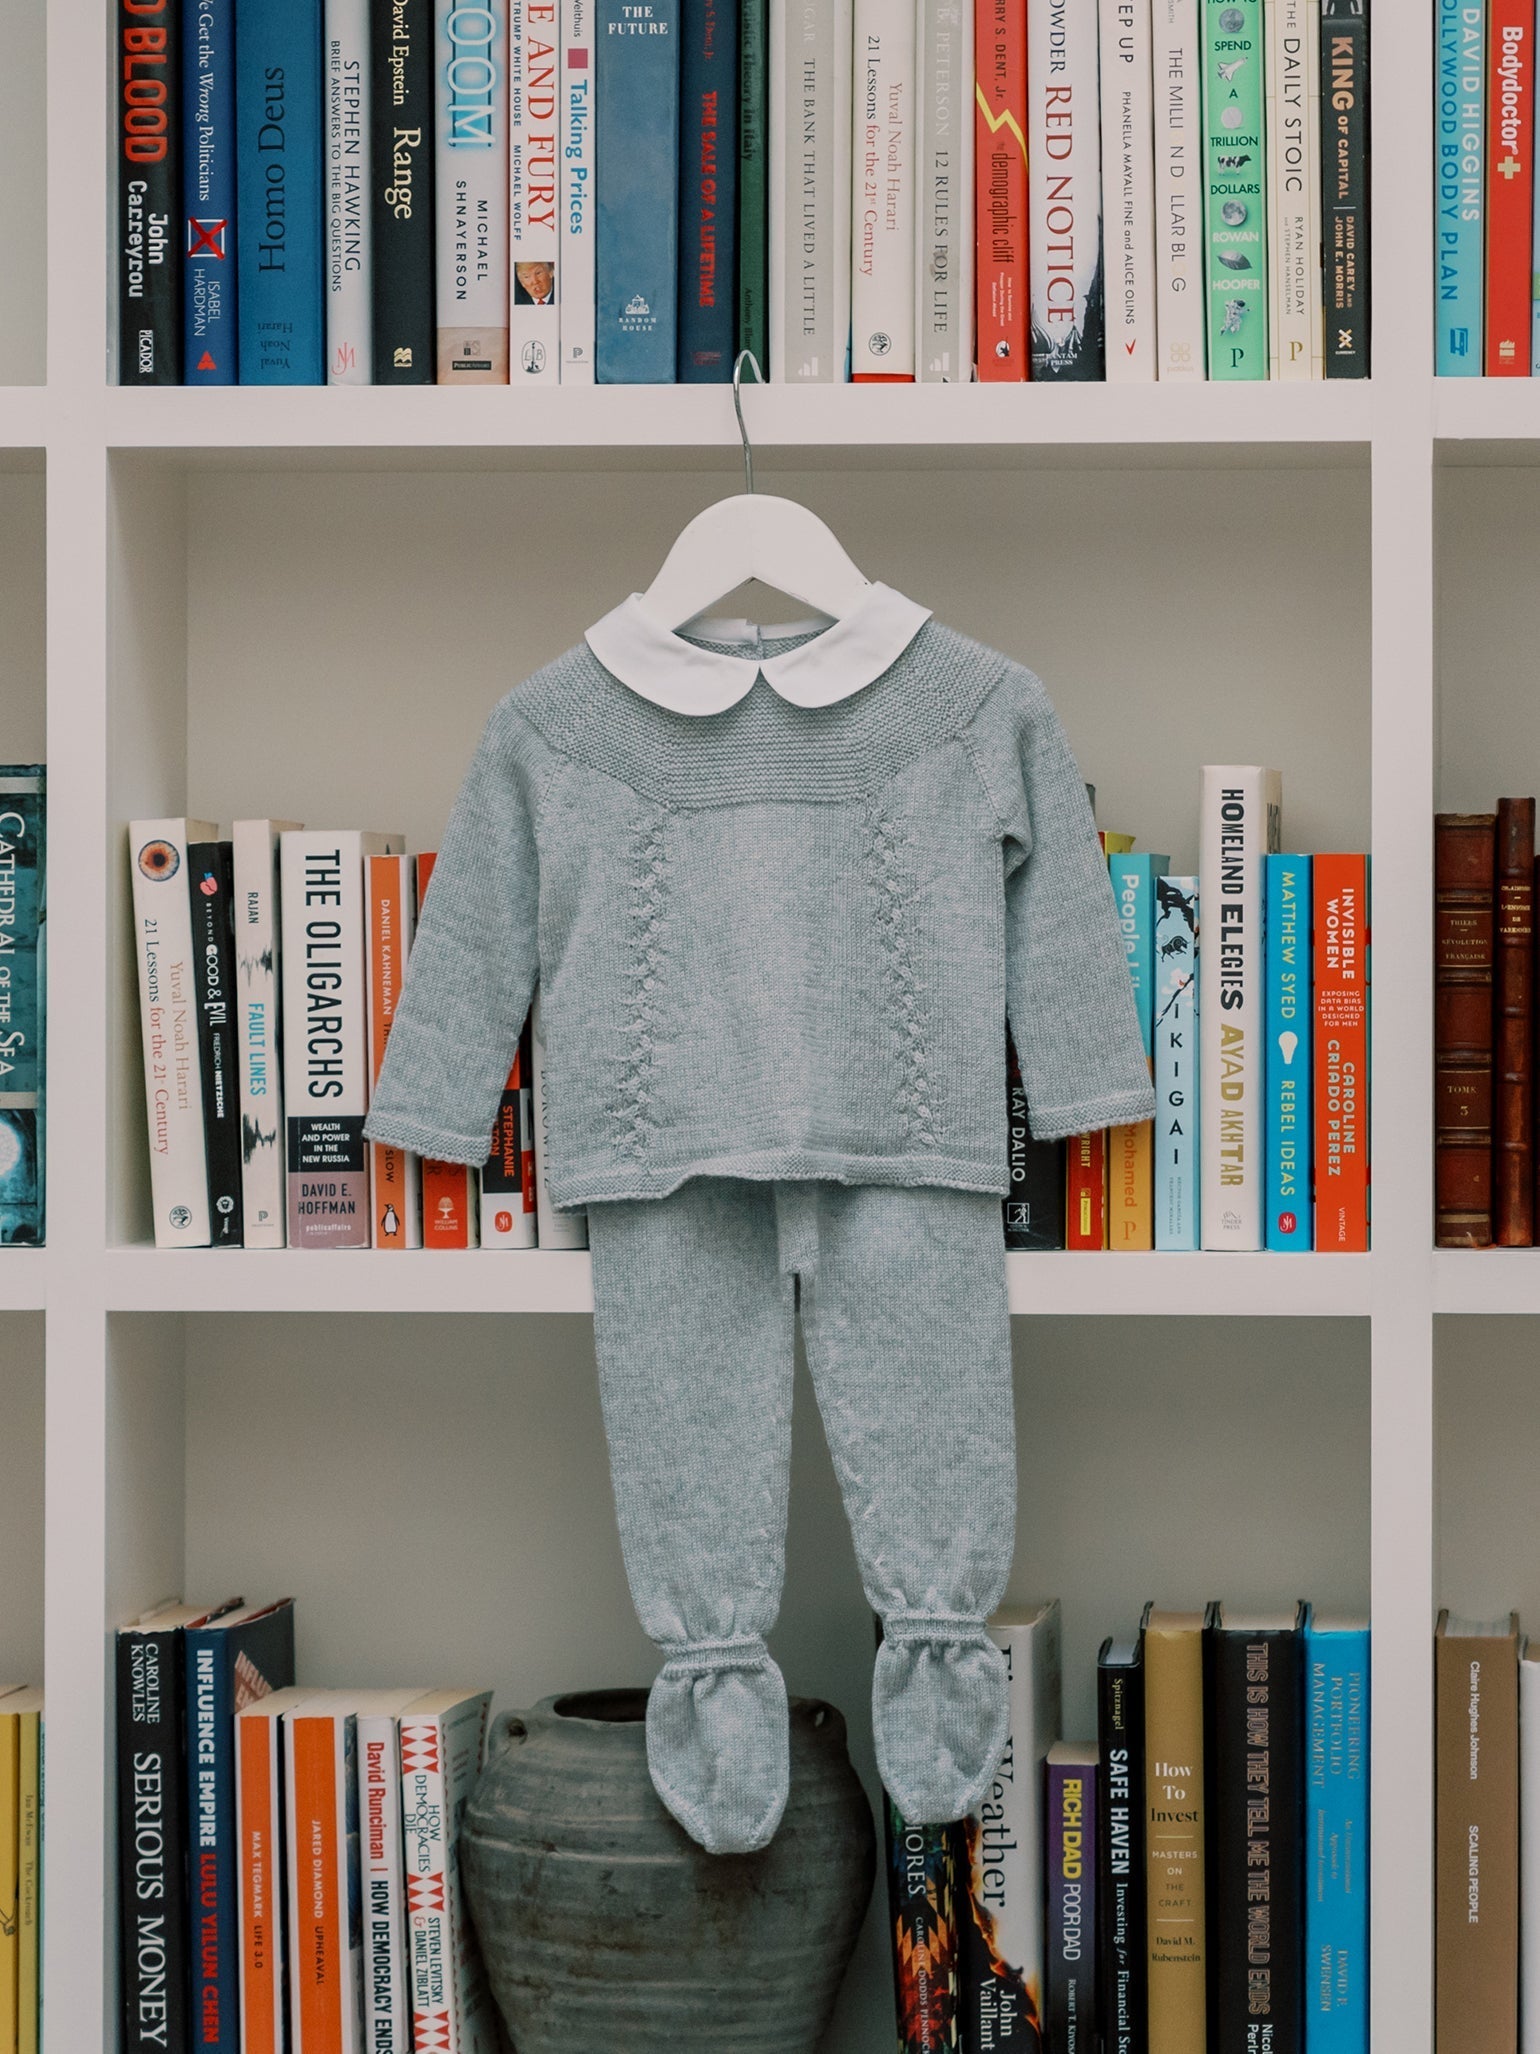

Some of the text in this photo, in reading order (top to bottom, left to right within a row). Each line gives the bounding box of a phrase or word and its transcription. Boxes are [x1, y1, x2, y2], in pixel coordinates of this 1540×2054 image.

[609, 23, 667, 34] FUTURE
[623, 7, 653, 17] THE
[1119, 38, 1133, 62] UP
[1215, 41, 1251, 51] SPEND
[123, 28, 167, 163] BLOOD
[388, 46, 409, 105] Epstein
[513, 2, 522, 126] TRUMP WHITE HOUSE
[1229, 89, 1238, 98] A
[1284, 1, 1302, 191] THE DAILY STOIC
[528, 36, 554, 231] AND FURY
[566, 80, 587, 234] Talking Prices
[859, 36, 880, 275] 21 Lessons for the 21st Century
[1211, 136, 1258, 146] TRILLION
[1332, 37, 1354, 199] KING OF CAPITAL
[1462, 9, 1480, 220] DAVID HIGGINS
[258, 68, 285, 272] Homo Deus
[344, 61, 360, 270] STEPHEN HAWKING
[385, 127, 421, 218] Range
[513, 145, 522, 240] MICHAEL WOLFF
[1046, 87, 1076, 323] RED NOTICE
[1211, 184, 1260, 194] DOLLARS
[125, 181, 147, 297] Carreyrou
[148, 213, 168, 264] John
[456, 181, 466, 299] SHNAYERSON
[478, 201, 487, 280] MICHAEL
[934, 152, 948, 332] 12 RULES FOR LIFE
[1213, 232, 1258, 242] ROWAN
[1441, 145, 1458, 299] BODY PLAN
[1213, 279, 1260, 290] HOOPER
[139, 330, 153, 373] PICADOR
[248, 892, 258, 923] RAJAN
[1221, 790, 1244, 1010] HOMELAND ELEGIES
[1327, 899, 1339, 968] WOMEN
[1343, 889, 1354, 978] INVISIBLE
[306, 850, 343, 1097] THE OLIGARCHS
[381, 900, 391, 1014] DANIEL KAHNEMAN
[1282, 872, 1296, 1018] MATTHEW SYED
[248, 1004, 266, 1096] FAULT LINES
[1323, 1012, 1360, 1020] DESIGNED
[1337, 1004, 1364, 1012] WORLD
[311, 1123, 340, 1131] WEALTH
[1012, 1087, 1026, 1181] RAY DALIO
[1221, 1024, 1244, 1185] AYAD AKHTAR
[1328, 1040, 1340, 1175] CRIADO PEREZ
[1343, 1063, 1355, 1153] CAROLINE
[1446, 1085, 1477, 1094] TOME
[1461, 1106, 1468, 1115] 3
[303, 1155, 320, 1163] NEW
[325, 1144, 338, 1152] THE
[385, 1150, 394, 1182] SLOW
[503, 1106, 514, 1176] STEPHANIE
[1281, 1081, 1295, 1195] REBEL IDEAS
[299, 1201, 355, 1214] HOFFMAN
[302, 1183, 351, 1197] DAVID E.
[1221, 1217, 1242, 1225] TINDER
[1338, 1208, 1346, 1241] VINTAGE
[131, 1645, 145, 1721] KNOWLES
[146, 1643, 159, 1723] CAROLINE
[1112, 1679, 1124, 1729] Spitznagel
[1313, 1664, 1325, 1789] MANAGEMENT
[1331, 1678, 1342, 1774] PORTFOLIO
[1348, 1673, 1360, 1779] PIONEERING
[1469, 1661, 1480, 1779] Claire Hughes Johnson
[197, 1650, 216, 1846] INFLUENCE EMPIRE
[1155, 1762, 1193, 1777] How
[1163, 1786, 1185, 1799] To
[367, 1743, 386, 1859] David Runciman
[1063, 1780, 1082, 1878] RICH DAD
[1110, 1750, 1129, 1873] SAFE HAVEN
[1152, 1808, 1198, 1822] Invest
[1247, 1643, 1270, 2015] THIS IS HOW THEY TELL ME THE WORLD ENDS
[371, 1881, 389, 1915] HOW
[1153, 1851, 1197, 1859] MASTERS
[1167, 1867, 1182, 1875] ON
[1469, 1826, 1478, 1923] SCALING PEOPLE
[134, 1753, 167, 2047] SERIOUS MONEY
[253, 1832, 263, 1968] MAX TEGMARK LIFE 3.0
[312, 1821, 324, 1984] JARED DIAMOND UPHEAVAL
[1063, 1884, 1081, 1960] POOR DAD
[1159, 1899, 1191, 1908] CRAFT
[201, 1854, 218, 2042] LULU YILUN CHEN
[373, 1922, 391, 2013] DEMOCRACY
[981, 1978, 997, 2050] Vaillant
[1000, 1990, 1013, 2037] John
